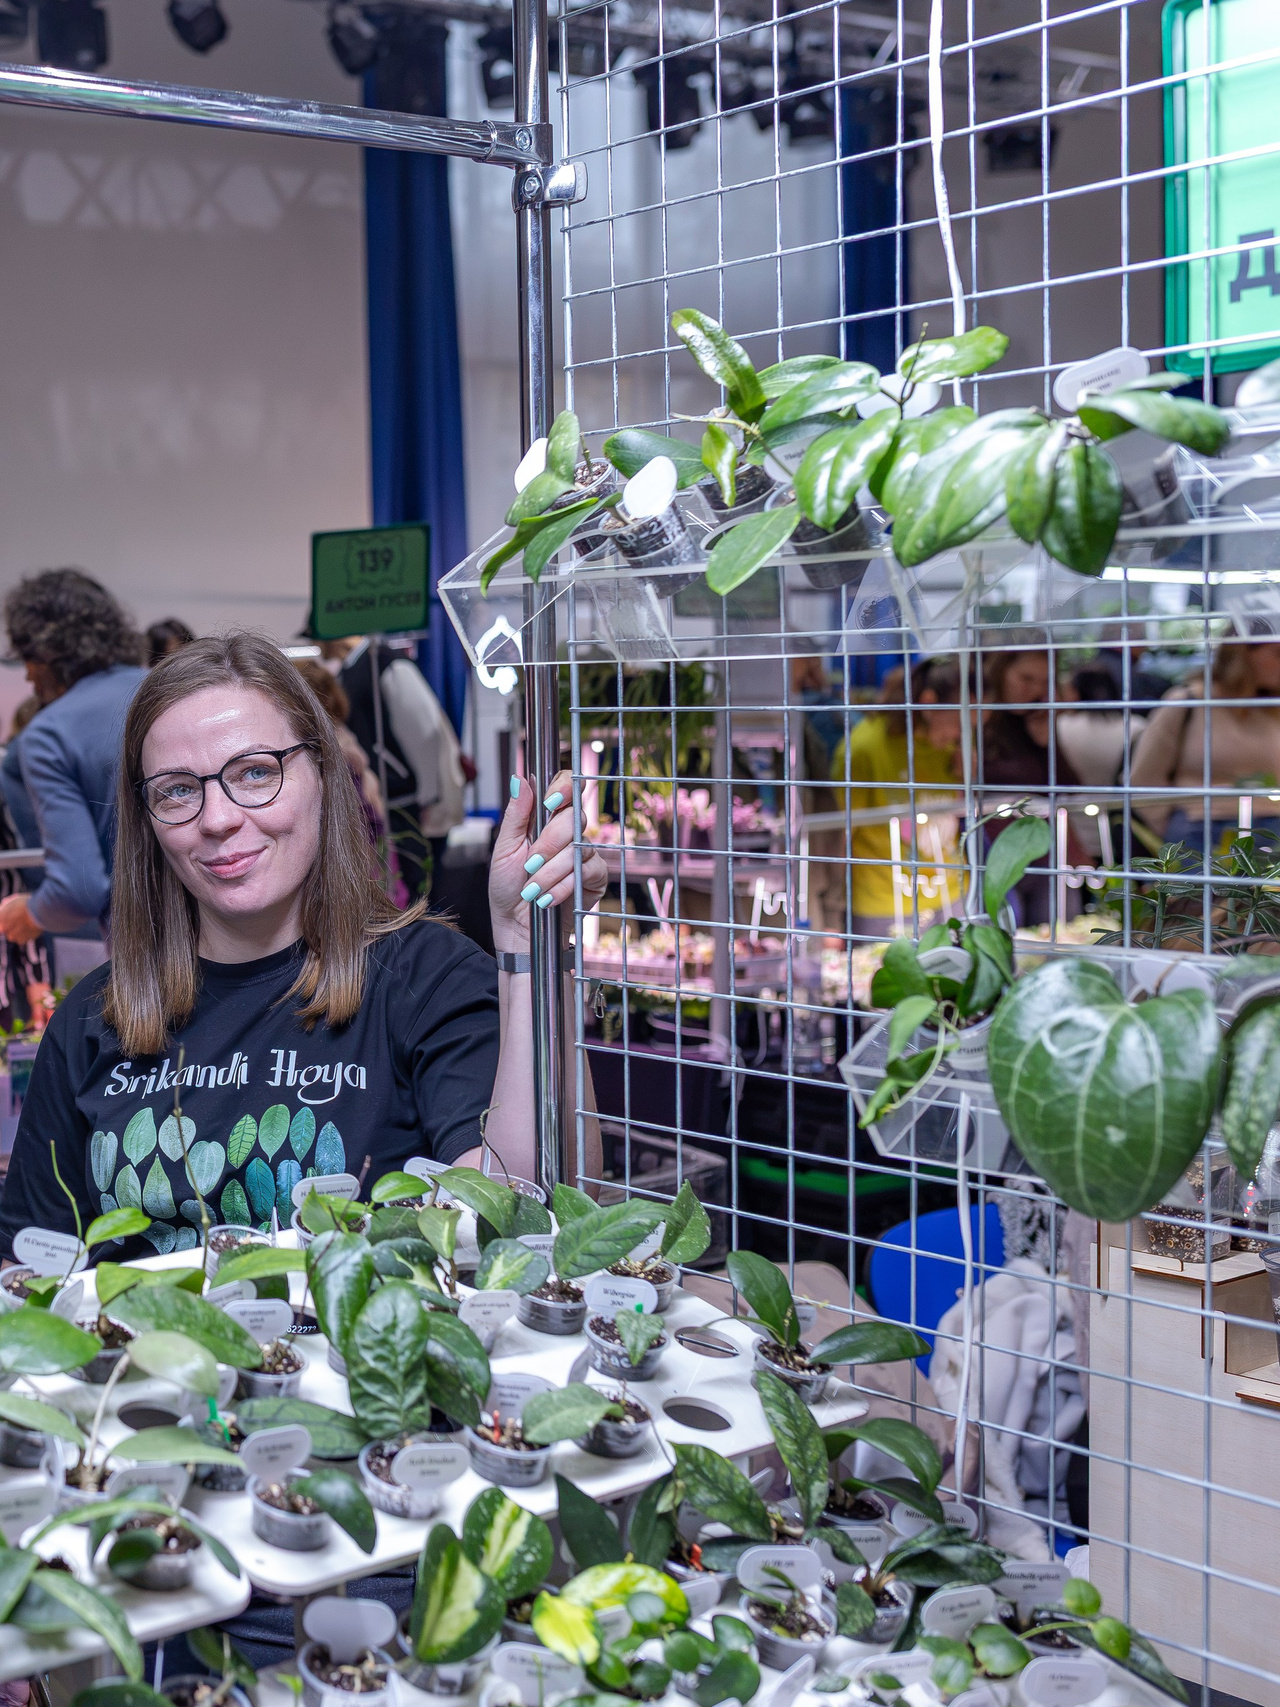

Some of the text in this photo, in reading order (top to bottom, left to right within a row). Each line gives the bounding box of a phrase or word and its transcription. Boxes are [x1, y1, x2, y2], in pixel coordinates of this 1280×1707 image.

[357, 547, 394, 573] 139
[325, 597, 376, 613] АНТОН
[104, 1049, 367, 1105] Srikandi Hoya
